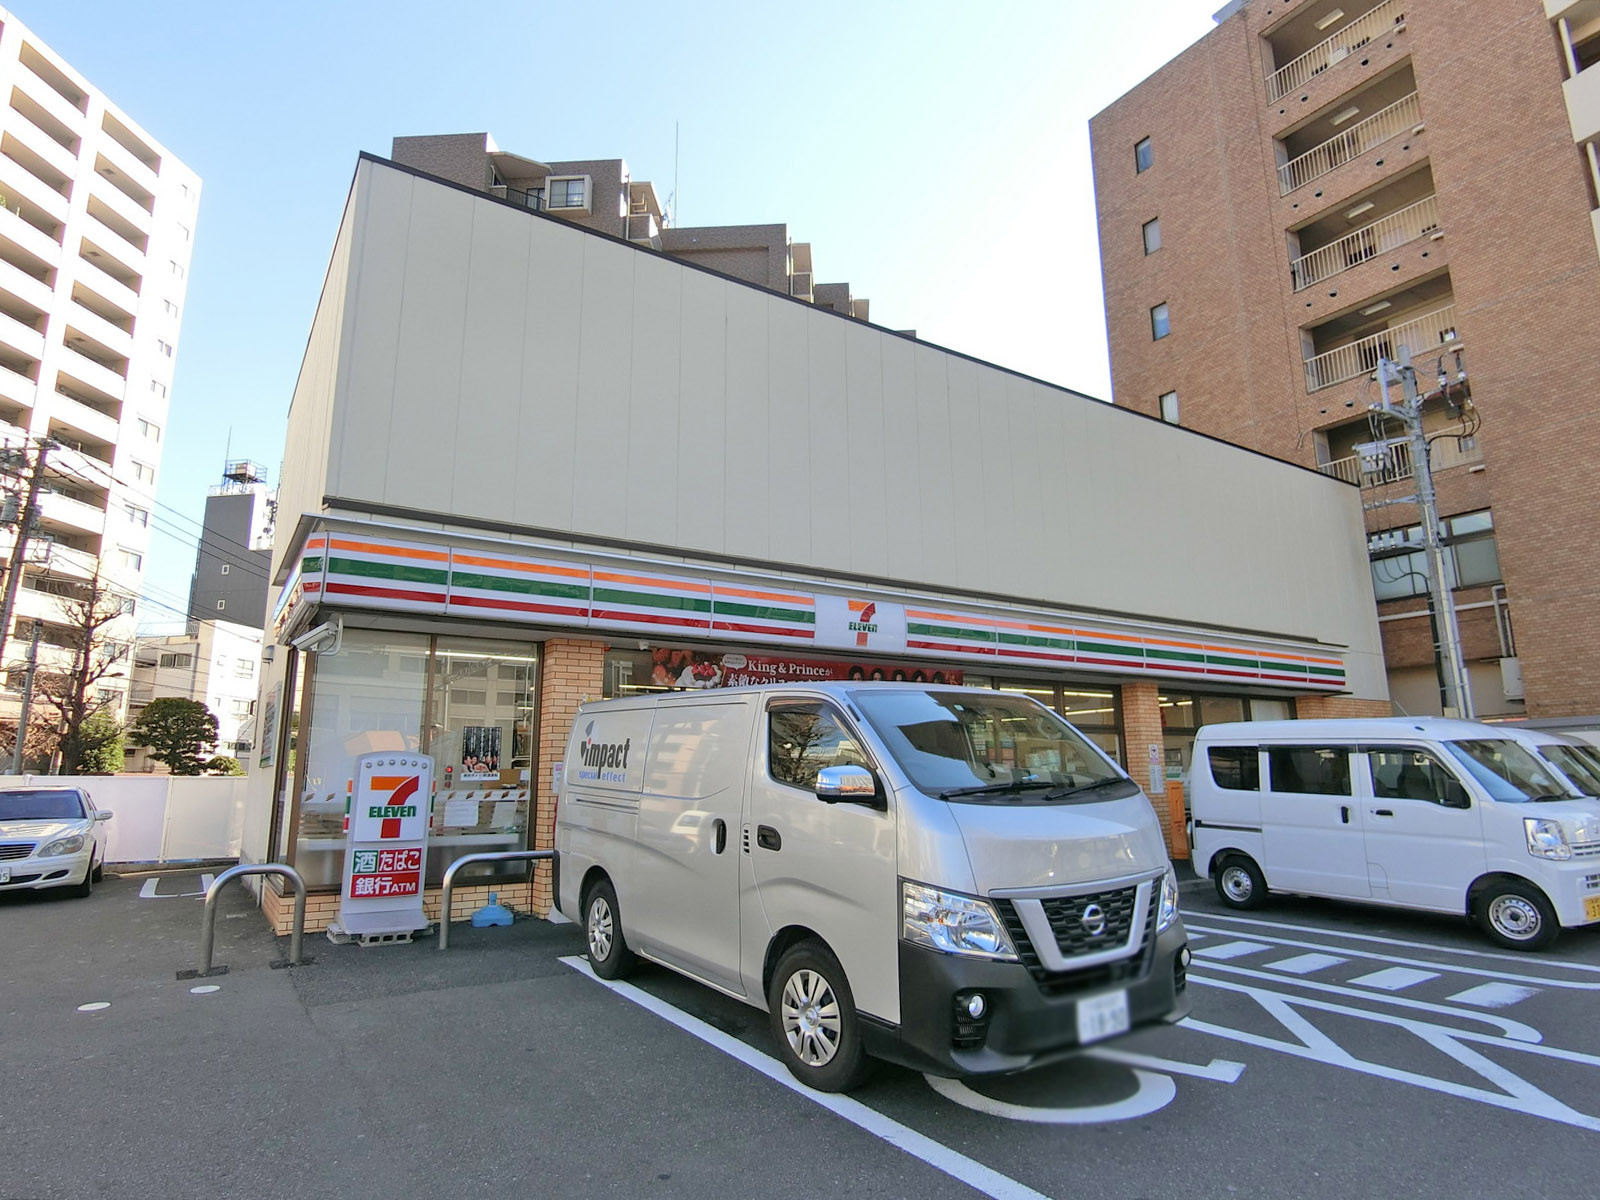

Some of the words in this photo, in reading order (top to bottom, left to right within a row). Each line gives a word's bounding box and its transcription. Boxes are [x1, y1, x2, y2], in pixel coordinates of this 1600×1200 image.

[848, 600, 876, 647] 7
[748, 660, 777, 675] King
[778, 662, 787, 674] &
[584, 737, 630, 779] impact
[602, 772, 626, 782] effect
[370, 775, 420, 838] 7
[354, 852, 378, 873] 酒
[379, 850, 420, 872] たばこ
